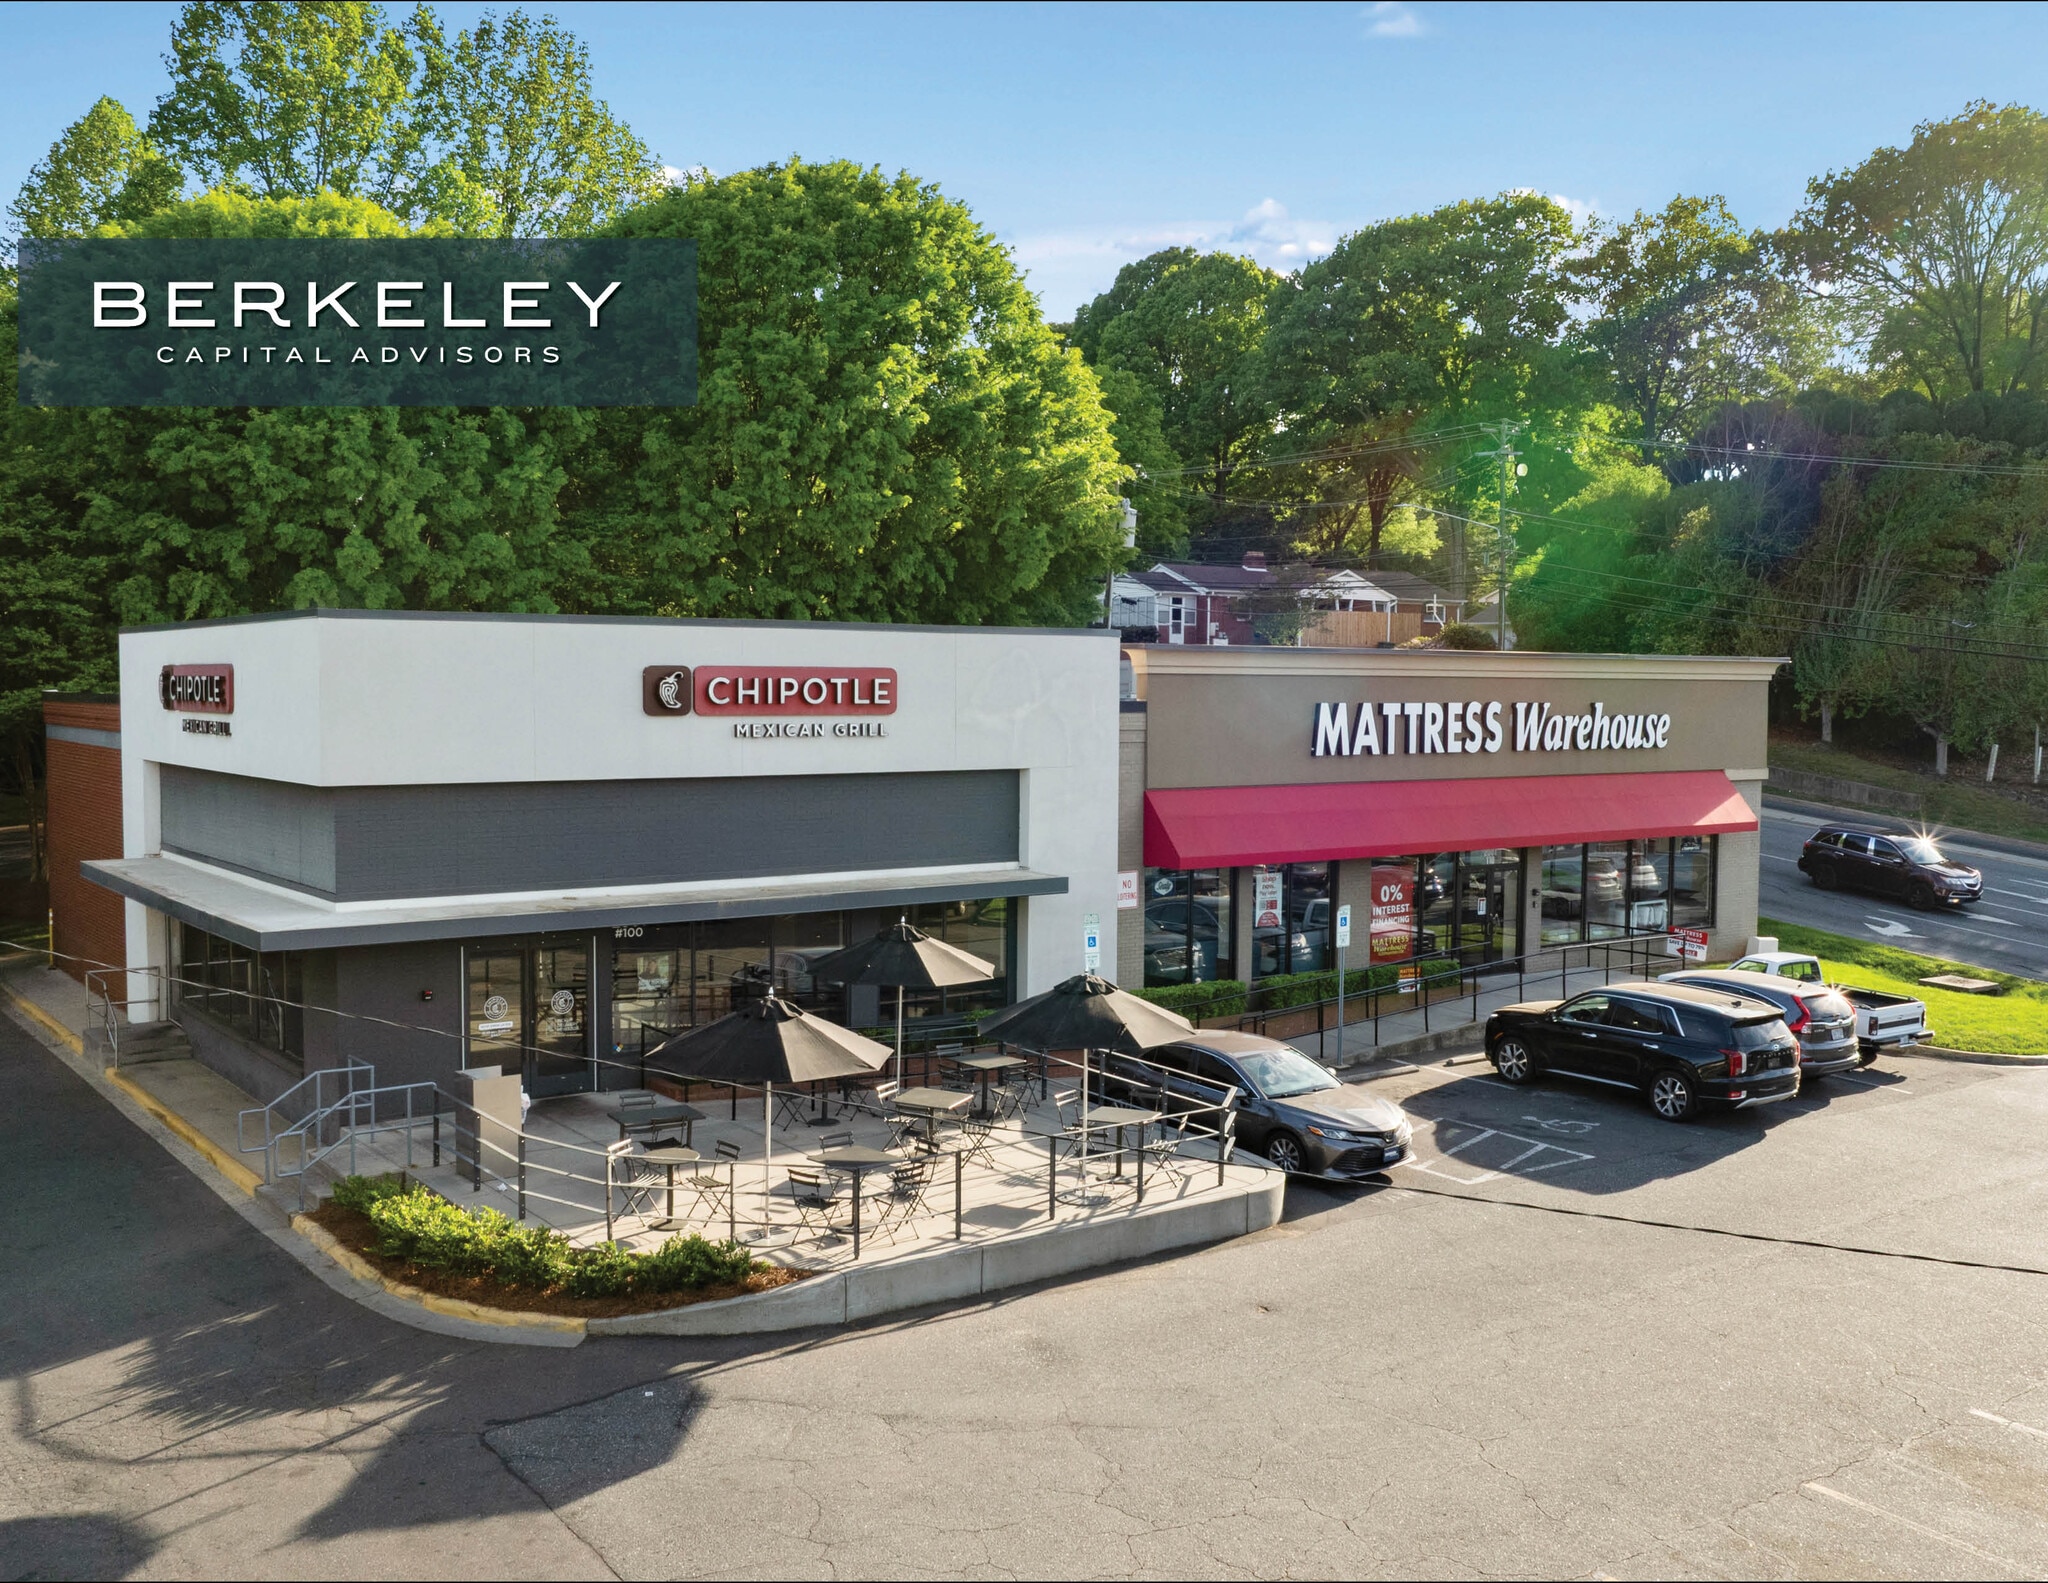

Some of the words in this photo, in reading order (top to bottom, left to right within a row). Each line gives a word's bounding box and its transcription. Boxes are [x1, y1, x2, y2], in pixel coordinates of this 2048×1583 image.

[169, 675, 220, 702] CHIPOTLE
[707, 676, 891, 705] CHIPOTLE
[182, 719, 208, 733] MEXICAN
[734, 723, 825, 738] MEXICAN
[832, 723, 889, 738] GRILL
[1312, 701, 1503, 756] MATTRESS
[1512, 702, 1671, 752] Warehouse
[1122, 879, 1132, 889] NO
[1380, 883, 1403, 902] 0%
[1372, 903, 1410, 916] INTEREST
[1372, 915, 1410, 927] FINANCING
[615, 926, 643, 938] #100
[1674, 928, 1703, 939] MATTRESS
[1372, 935, 1410, 947] MATTRESS
